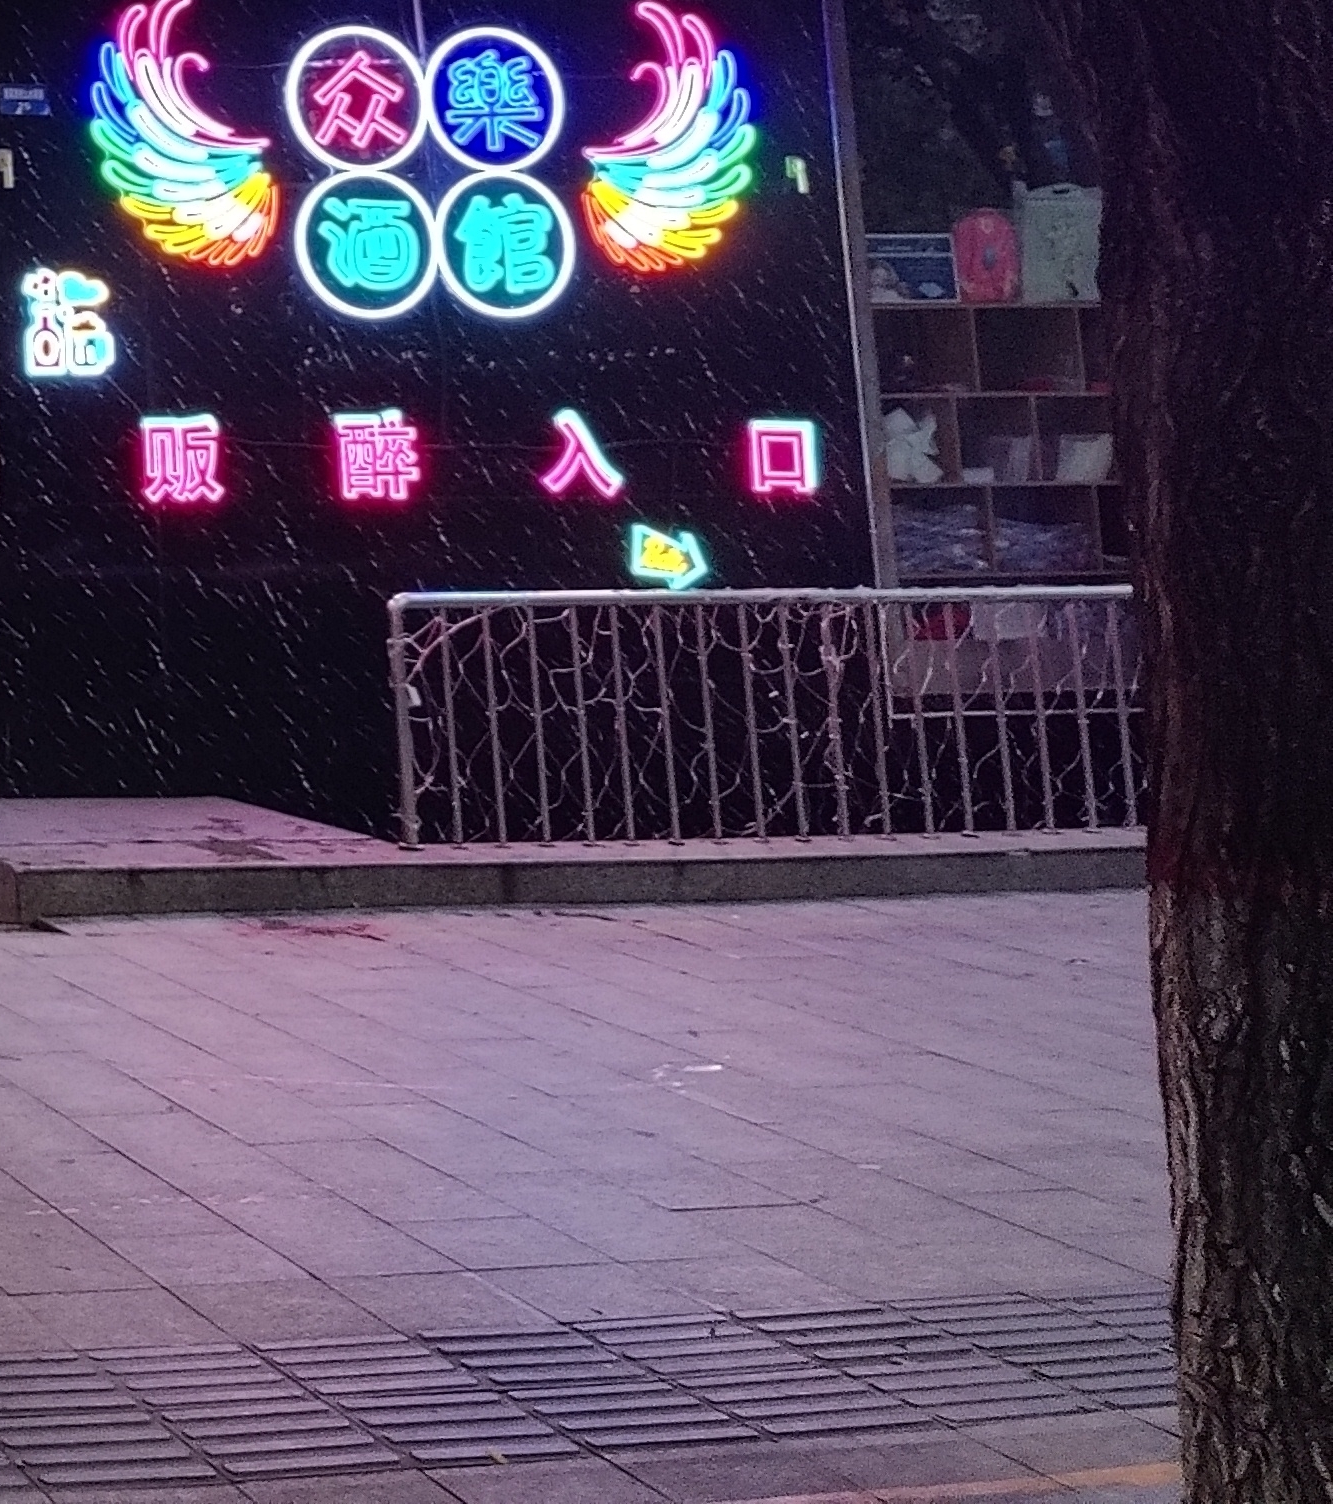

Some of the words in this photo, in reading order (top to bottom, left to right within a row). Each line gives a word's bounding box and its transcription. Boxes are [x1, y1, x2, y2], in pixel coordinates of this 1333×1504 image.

[313, 49, 545, 153] 众樂
[317, 193, 555, 295] 酒館
[139, 408, 819, 501] 贩醉入口
